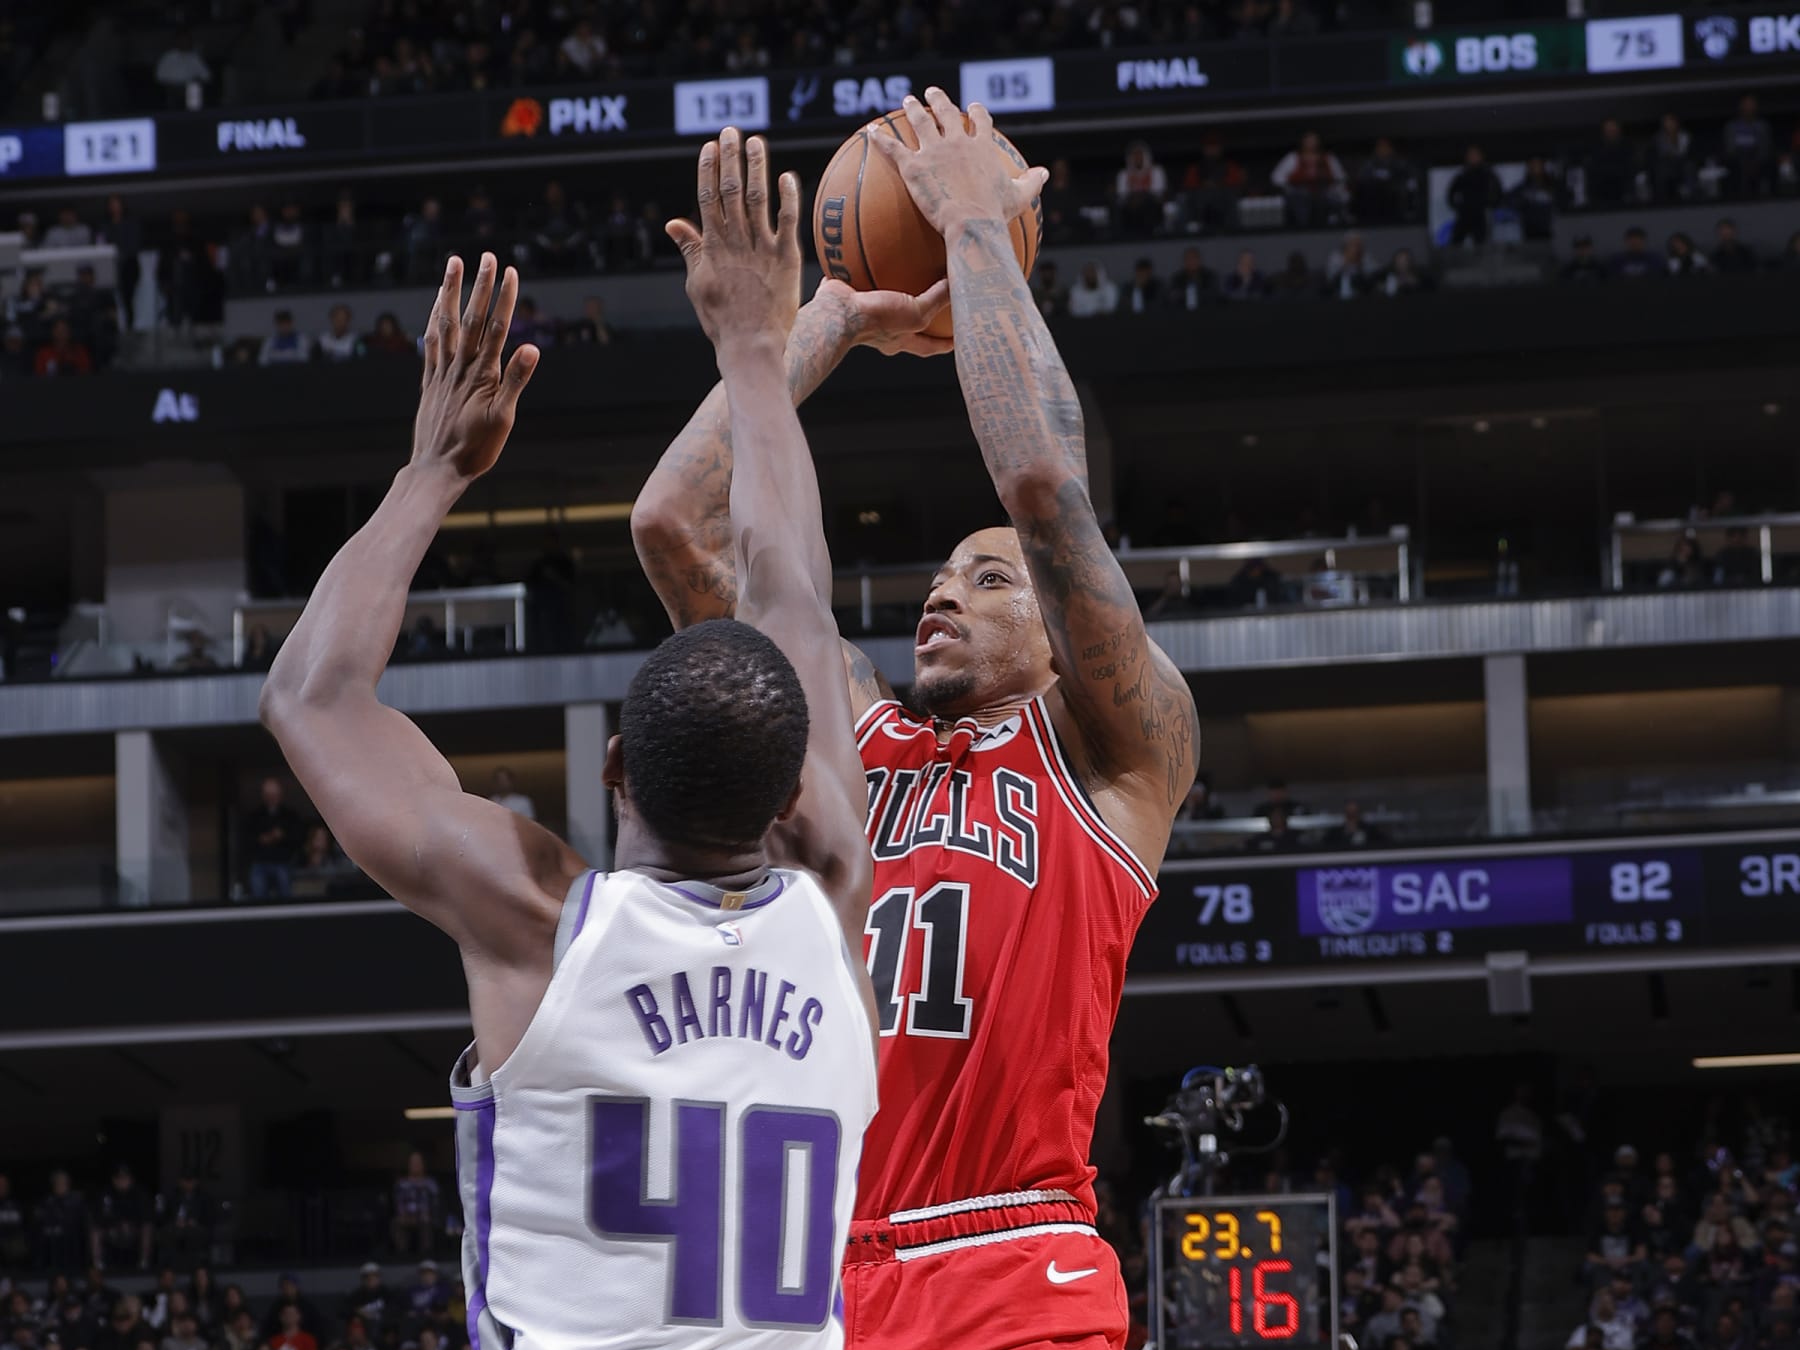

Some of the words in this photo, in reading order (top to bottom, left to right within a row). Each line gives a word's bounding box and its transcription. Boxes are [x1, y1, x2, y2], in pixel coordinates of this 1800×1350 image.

[83, 132, 140, 162] 121
[217, 116, 306, 153] FINAL
[548, 94, 628, 135] PHX
[693, 88, 757, 122] 133
[832, 75, 913, 117] SAS
[1117, 56, 1209, 92] FINAL
[1455, 34, 1539, 75] BOS
[1611, 30, 1657, 60] 75
[1193, 885, 1253, 926] 78
[1391, 872, 1491, 915] SAC
[1609, 861, 1673, 904] 82
[1176, 943, 1249, 966] FOULS
[1256, 940, 1273, 963] 3
[1318, 932, 1427, 957] TIMEOUTS
[1586, 923, 1655, 945] FOULS
[1665, 920, 1683, 941] 3
[865, 881, 974, 1040] 11
[625, 965, 824, 1062] BARNES
[585, 1095, 842, 1333] 40
[1180, 1211, 1283, 1262] 23.7
[1227, 1259, 1300, 1341] 16
